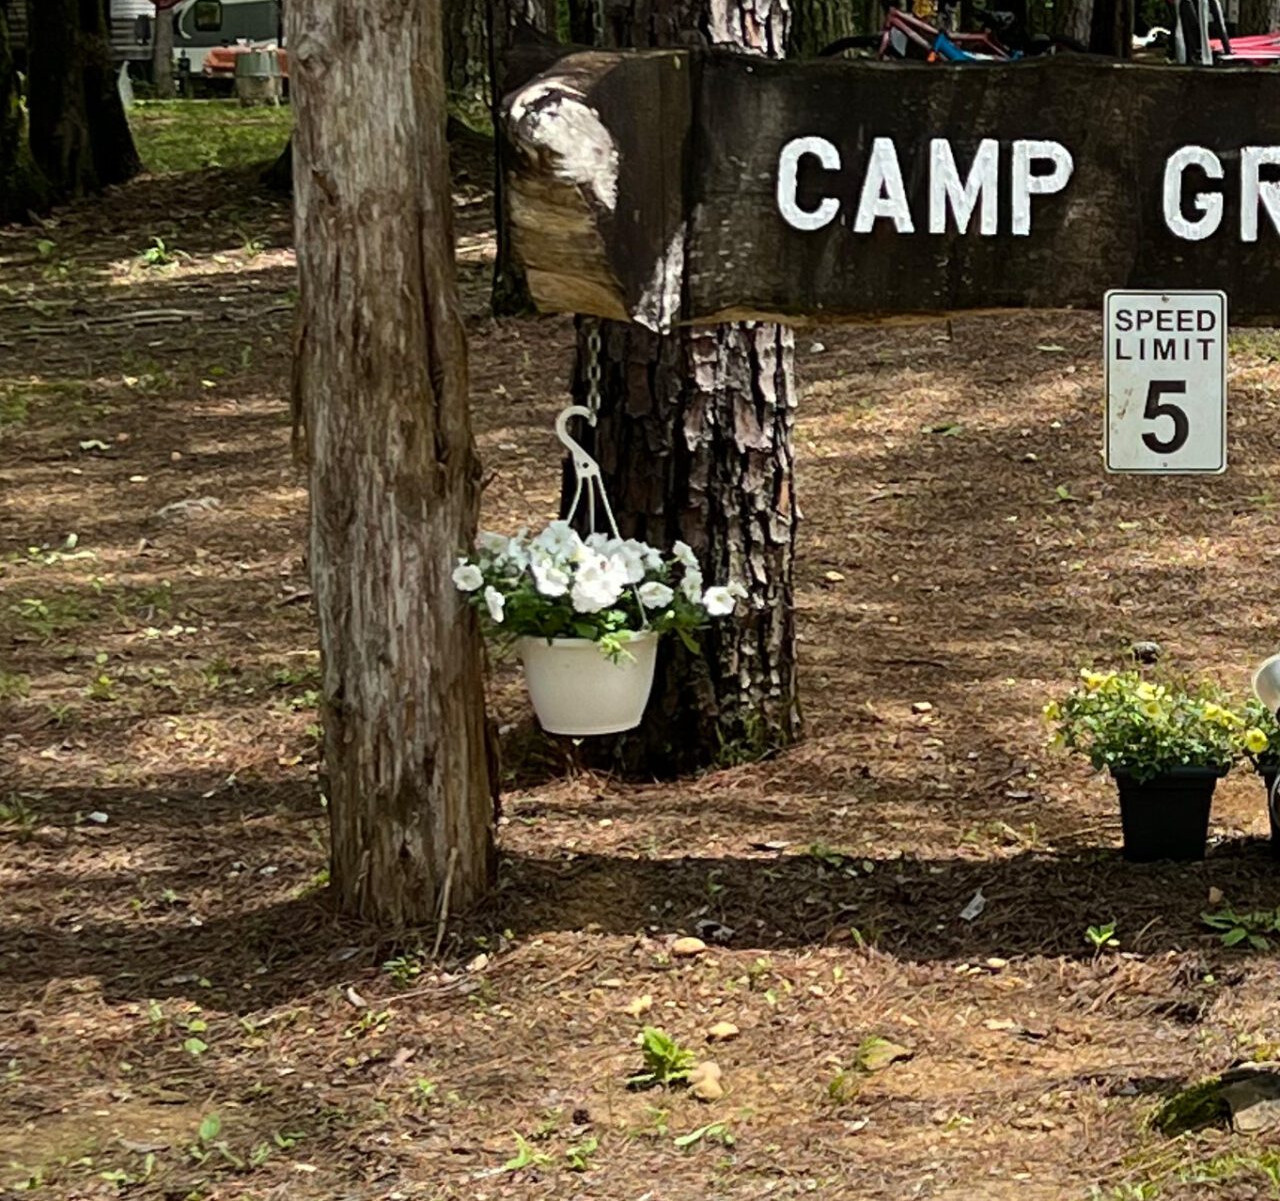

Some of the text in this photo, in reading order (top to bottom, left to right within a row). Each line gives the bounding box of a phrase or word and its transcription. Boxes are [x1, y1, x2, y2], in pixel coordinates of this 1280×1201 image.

[777, 135, 1074, 236] CAMP
[1114, 309, 1217, 332] SPEED
[1115, 338, 1216, 361] LIMIT
[1141, 380, 1190, 455] 5
